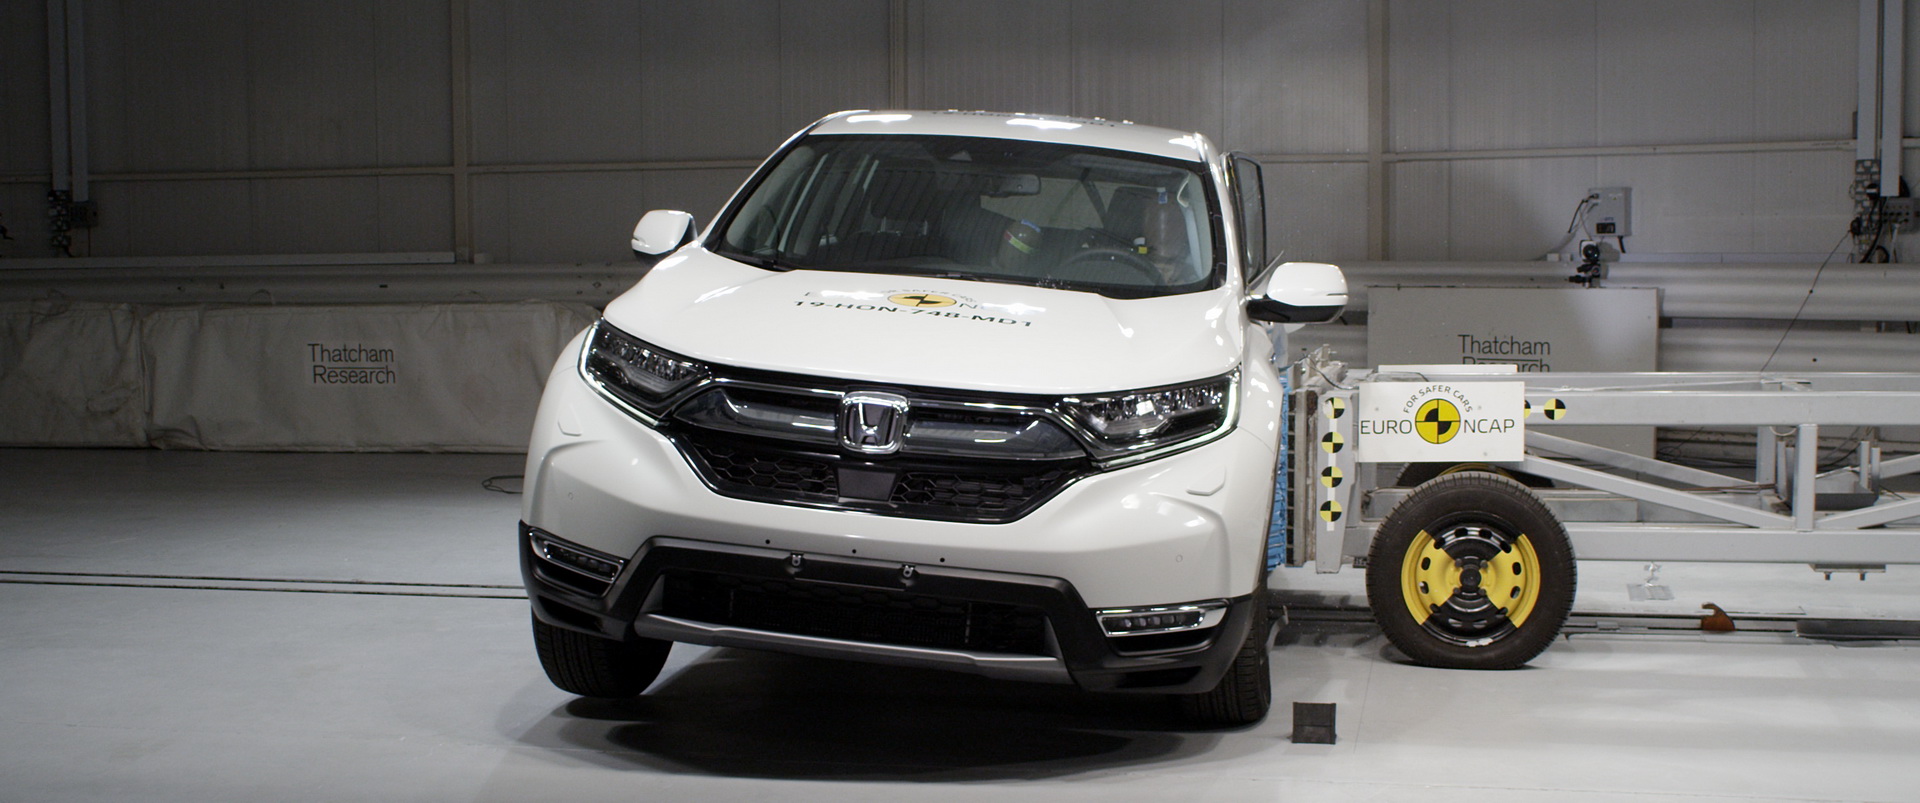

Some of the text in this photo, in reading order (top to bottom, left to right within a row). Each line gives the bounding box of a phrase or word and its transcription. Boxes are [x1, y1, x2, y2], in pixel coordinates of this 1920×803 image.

[795, 301, 1031, 327] 19-HON-748-MD1
[307, 343, 394, 362] Thatcham
[1457, 334, 1550, 355] Thatcham
[313, 365, 396, 384] Research
[1403, 385, 1473, 413] FOR SAFER CARS
[1360, 419, 1515, 434] EURO NCAP
